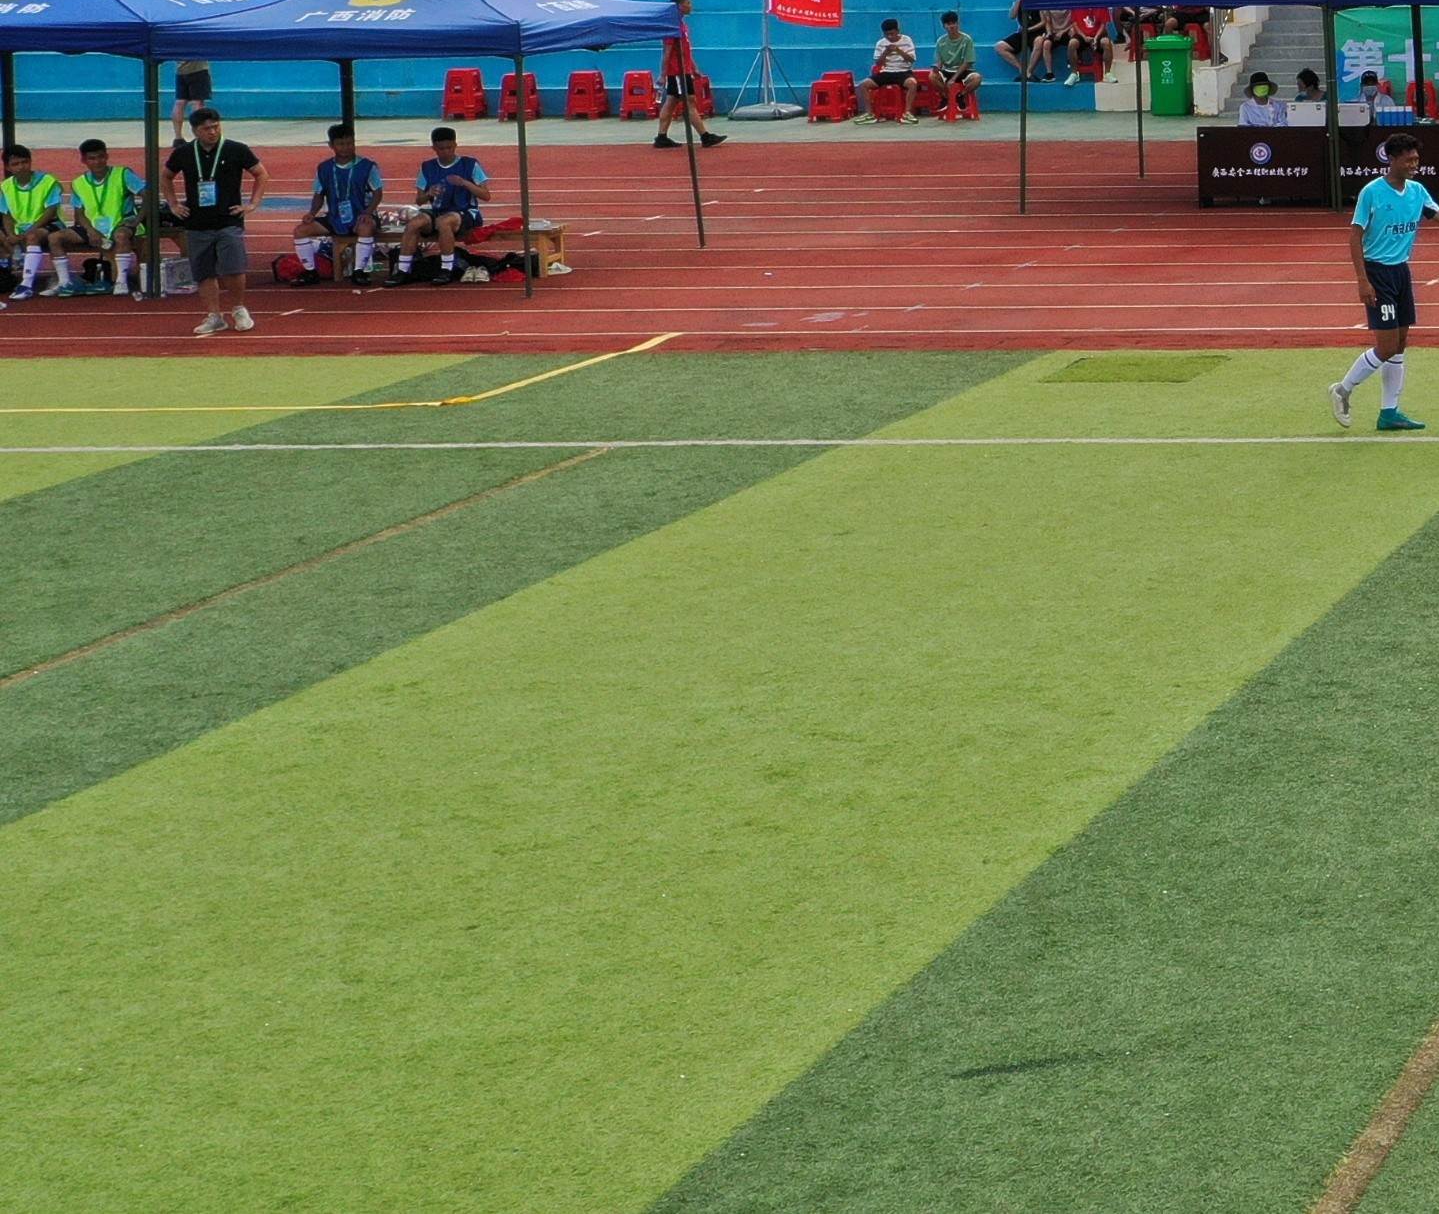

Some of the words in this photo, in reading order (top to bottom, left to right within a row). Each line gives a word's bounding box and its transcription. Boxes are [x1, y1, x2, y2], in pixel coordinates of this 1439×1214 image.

[294, 7, 437, 23] 广西消防
[1380, 303, 1396, 322] 94
